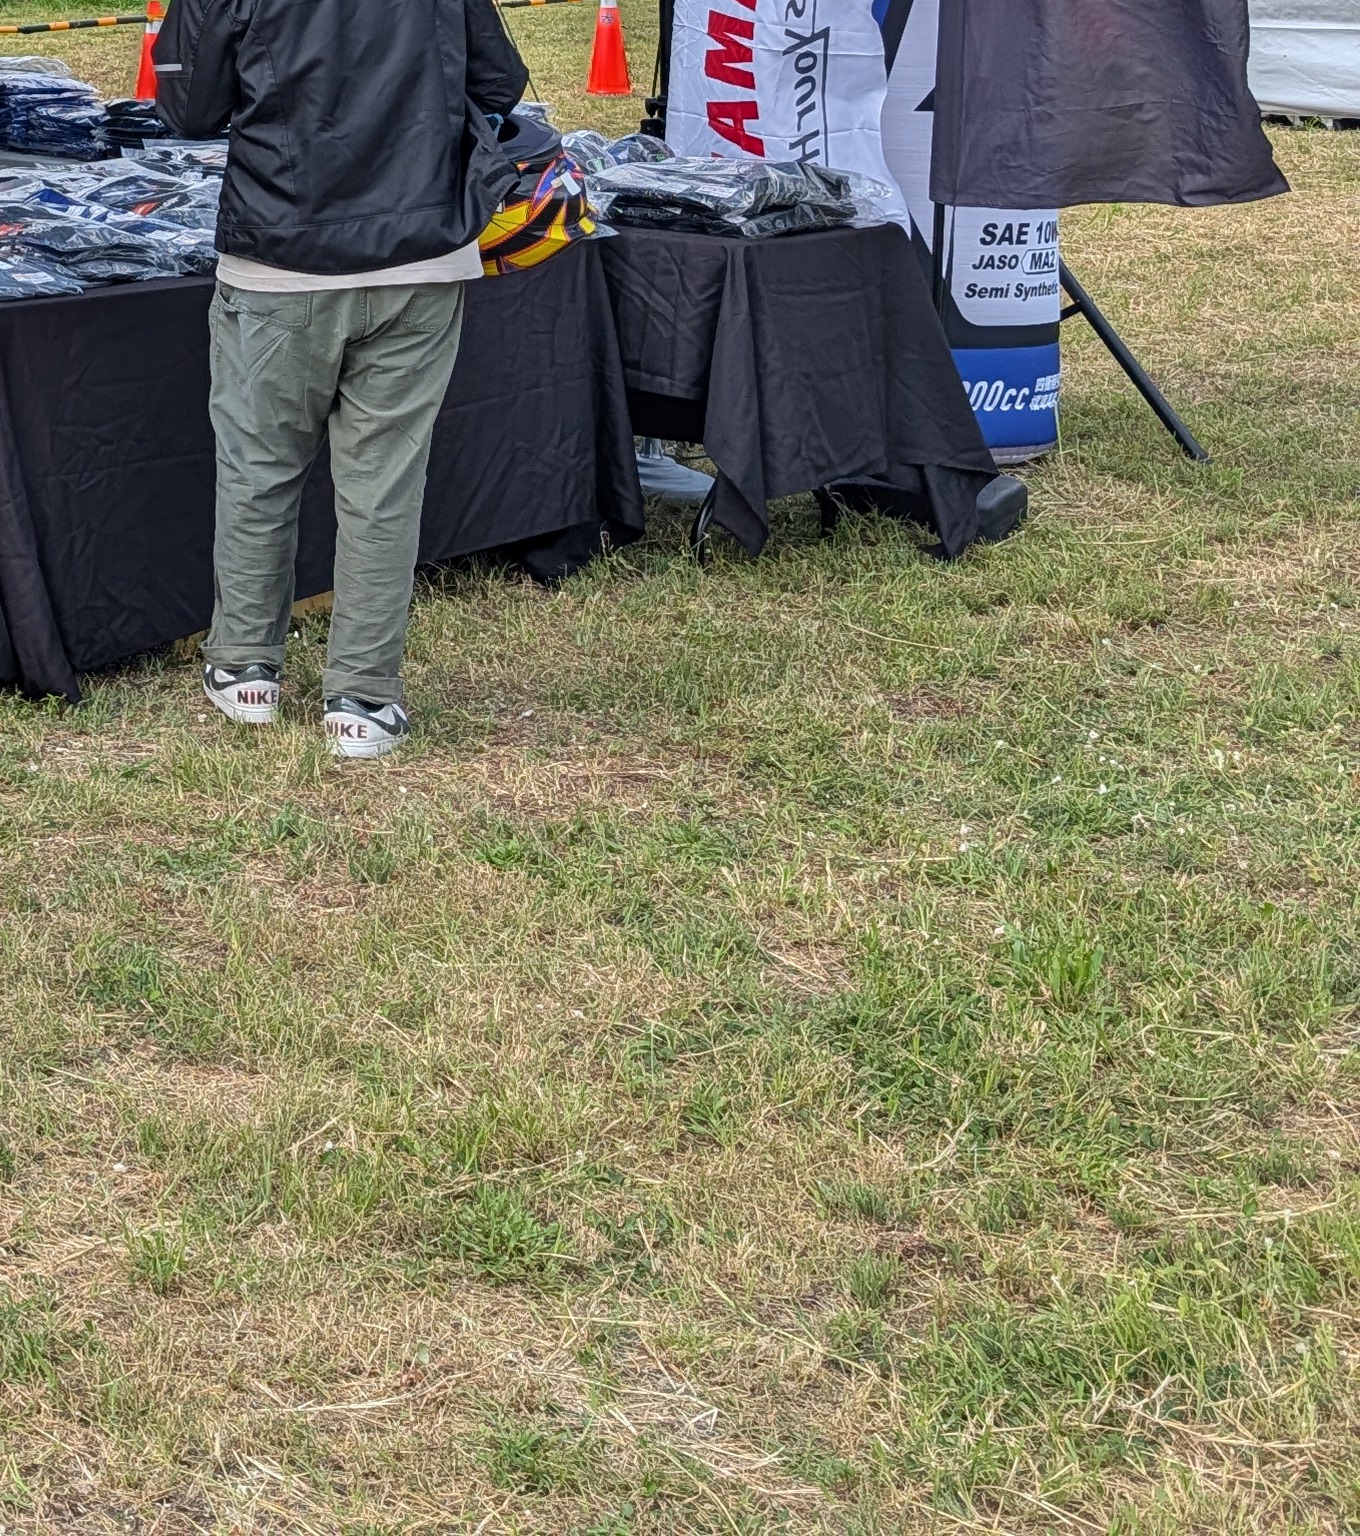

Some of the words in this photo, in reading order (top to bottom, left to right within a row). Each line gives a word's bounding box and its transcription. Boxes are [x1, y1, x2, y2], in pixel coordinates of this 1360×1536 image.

[980, 222, 1030, 246] SAE
[972, 254, 1020, 270] JASO
[1029, 251, 1056, 270] MA2
[964, 282, 1011, 299] Semi
[1013, 278, 1059, 302] Synthetic
[236, 689, 278, 705] NIKE
